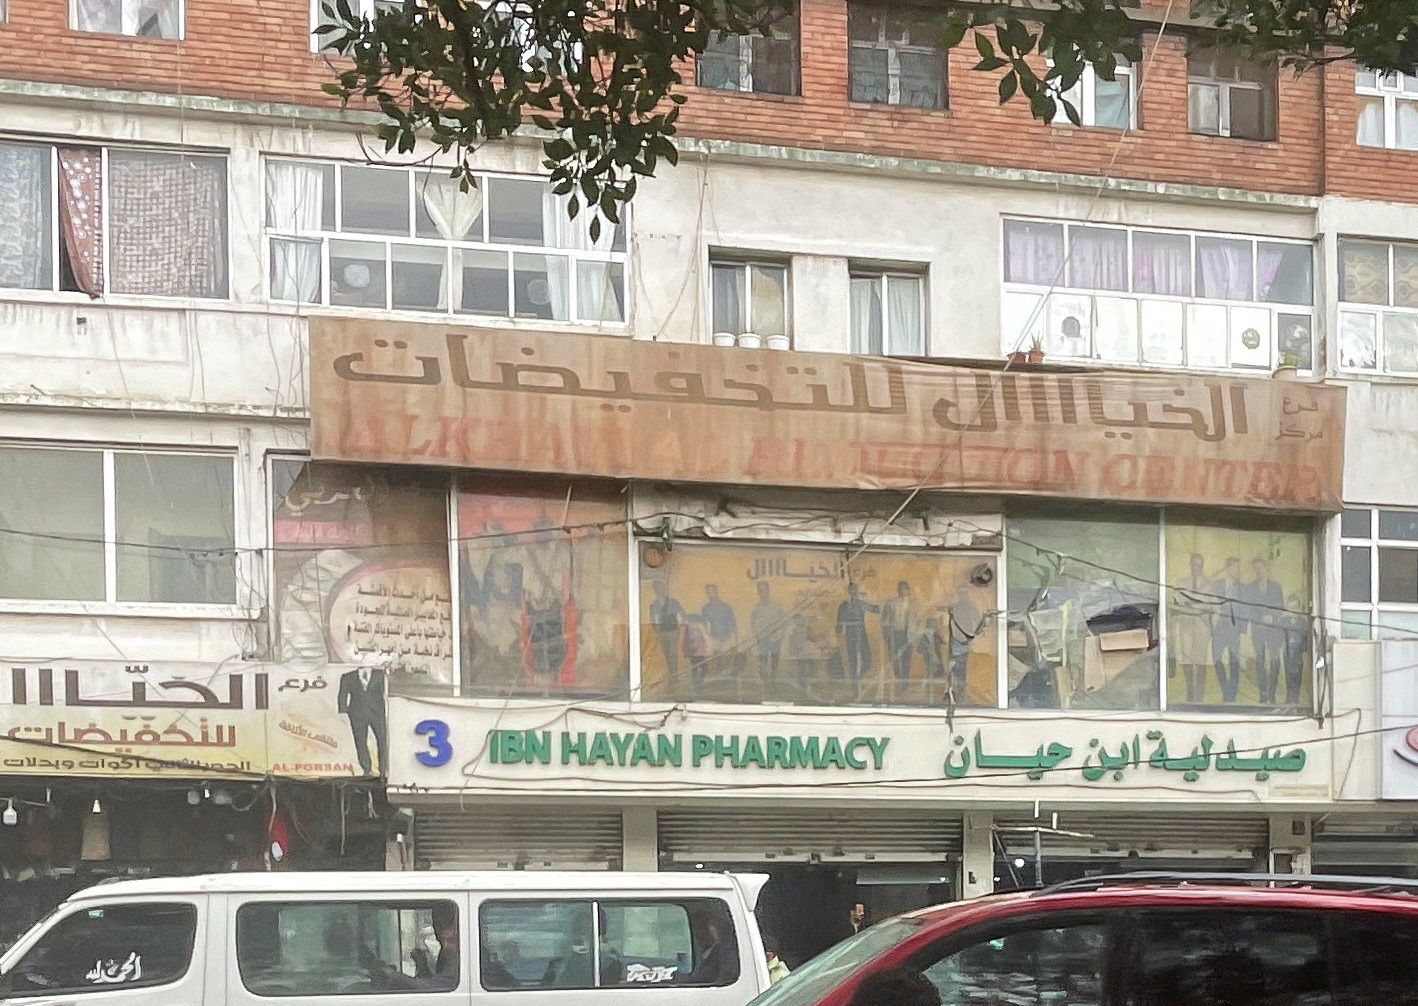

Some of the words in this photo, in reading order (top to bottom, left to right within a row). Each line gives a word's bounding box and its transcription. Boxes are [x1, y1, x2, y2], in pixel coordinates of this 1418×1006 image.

[333, 333, 908, 416] للتخفيضات
[278, 676, 328, 692] فرع
[414, 719, 454, 767] 3
[489, 729, 551, 765] IBN
[560, 732, 683, 768] HAYAN
[691, 733, 891, 770] PHARMACY
[944, 728, 1073, 781] حيان
[1082, 733, 1139, 782] ابن
[1146, 730, 1307, 782] صيدلية
